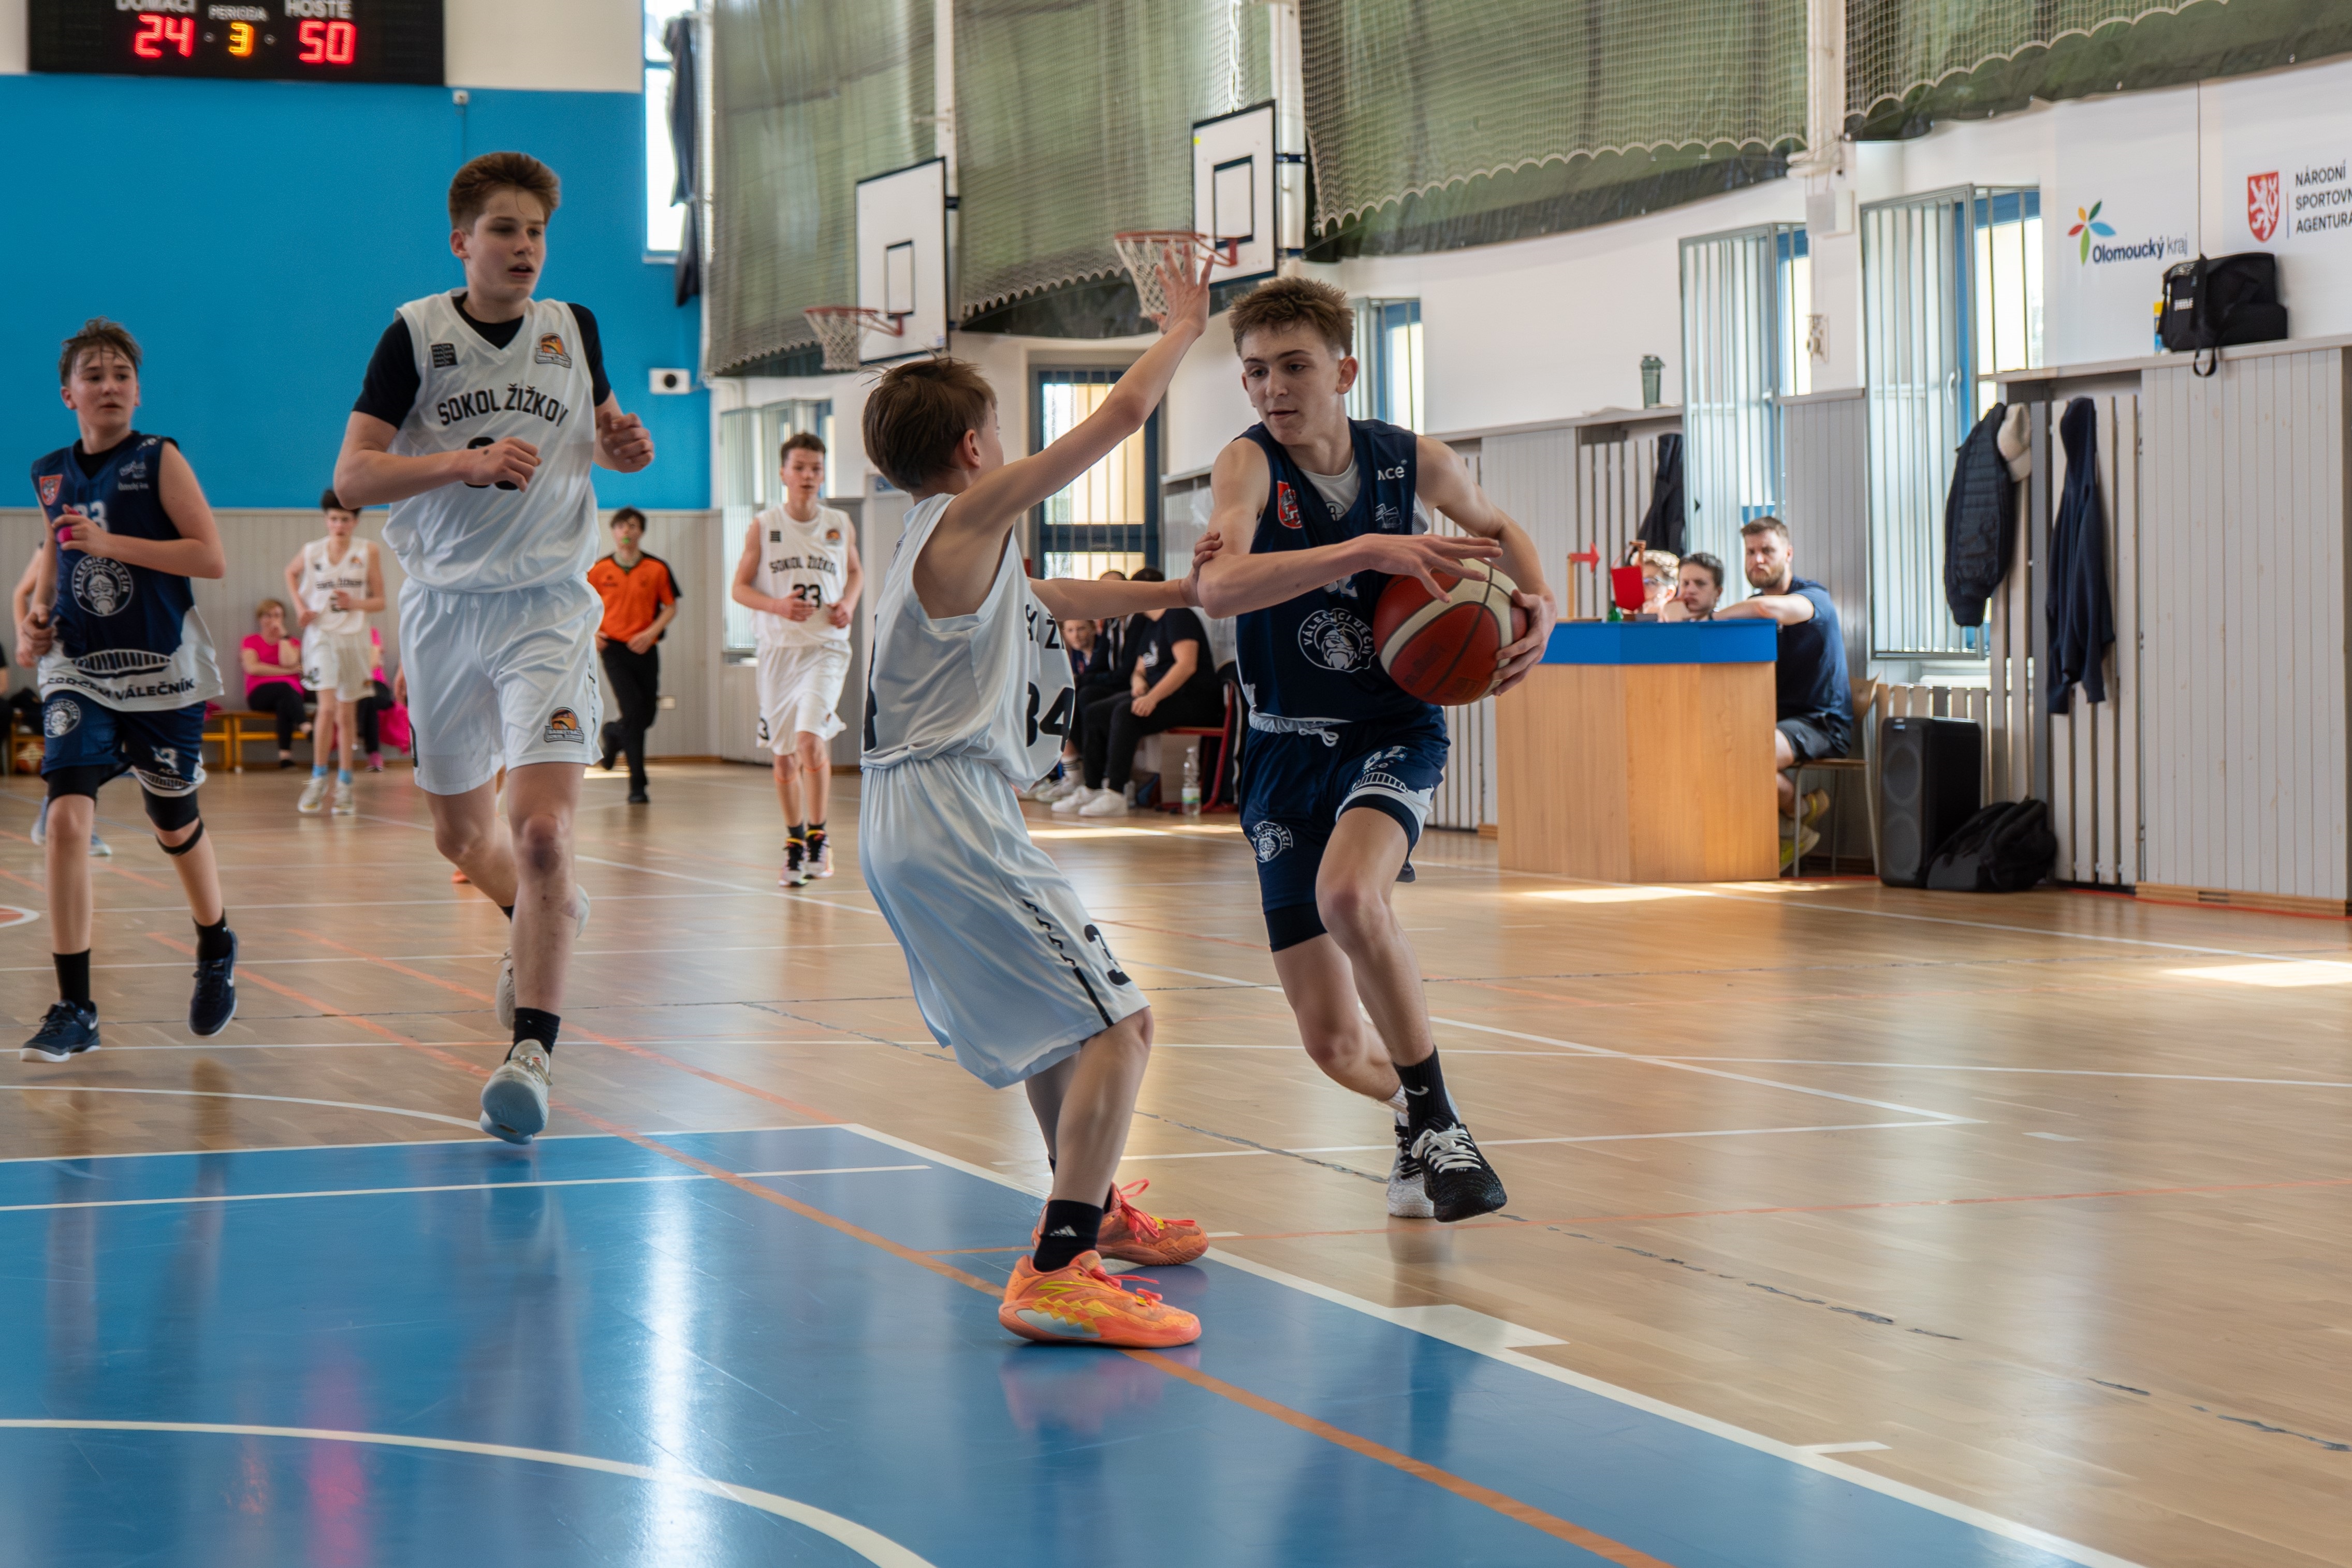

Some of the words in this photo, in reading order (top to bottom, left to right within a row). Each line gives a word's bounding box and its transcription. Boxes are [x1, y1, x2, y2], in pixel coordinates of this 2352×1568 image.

[135, 14, 195, 57] 24
[229, 22, 254, 56] 3
[299, 20, 356, 64] 50
[2296, 159, 2346, 187] NÁRODNÍ
[2093, 236, 2164, 263] Olomoucký
[2167, 232, 2187, 256] kraj
[438, 389, 501, 426] SOKOL
[504, 383, 568, 427] ŽIŽKOV
